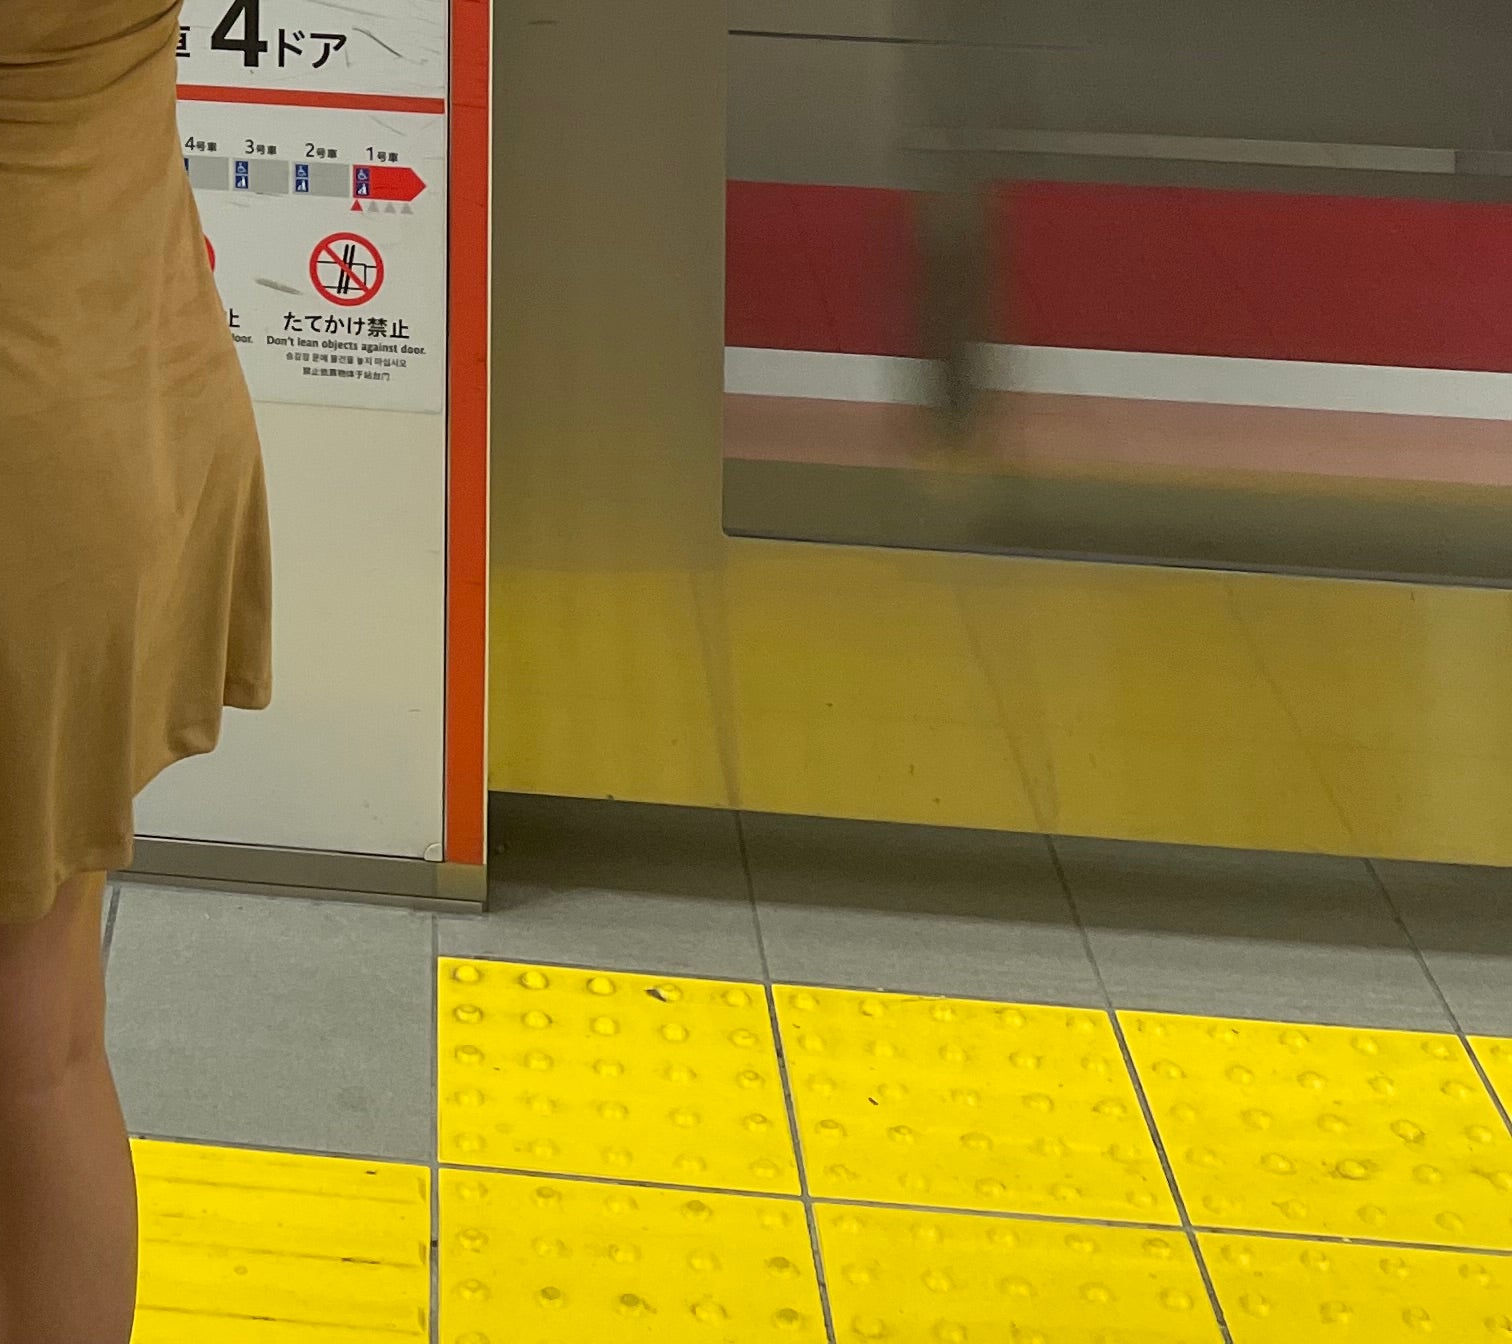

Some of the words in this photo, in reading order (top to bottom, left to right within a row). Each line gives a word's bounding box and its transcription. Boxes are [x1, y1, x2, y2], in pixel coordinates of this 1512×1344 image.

[185, 136, 217, 152] 4号車
[245, 139, 277, 156] 3号車
[305, 142, 338, 159] 2号車
[366, 146, 398, 162] 1号車
[284, 312, 410, 340] たてかけ禁止
[266, 336, 294, 346] Don't
[297, 337, 318, 348] lean
[322, 339, 358, 351] objects
[361, 342, 398, 354] against
[401, 344, 427, 354] door.
